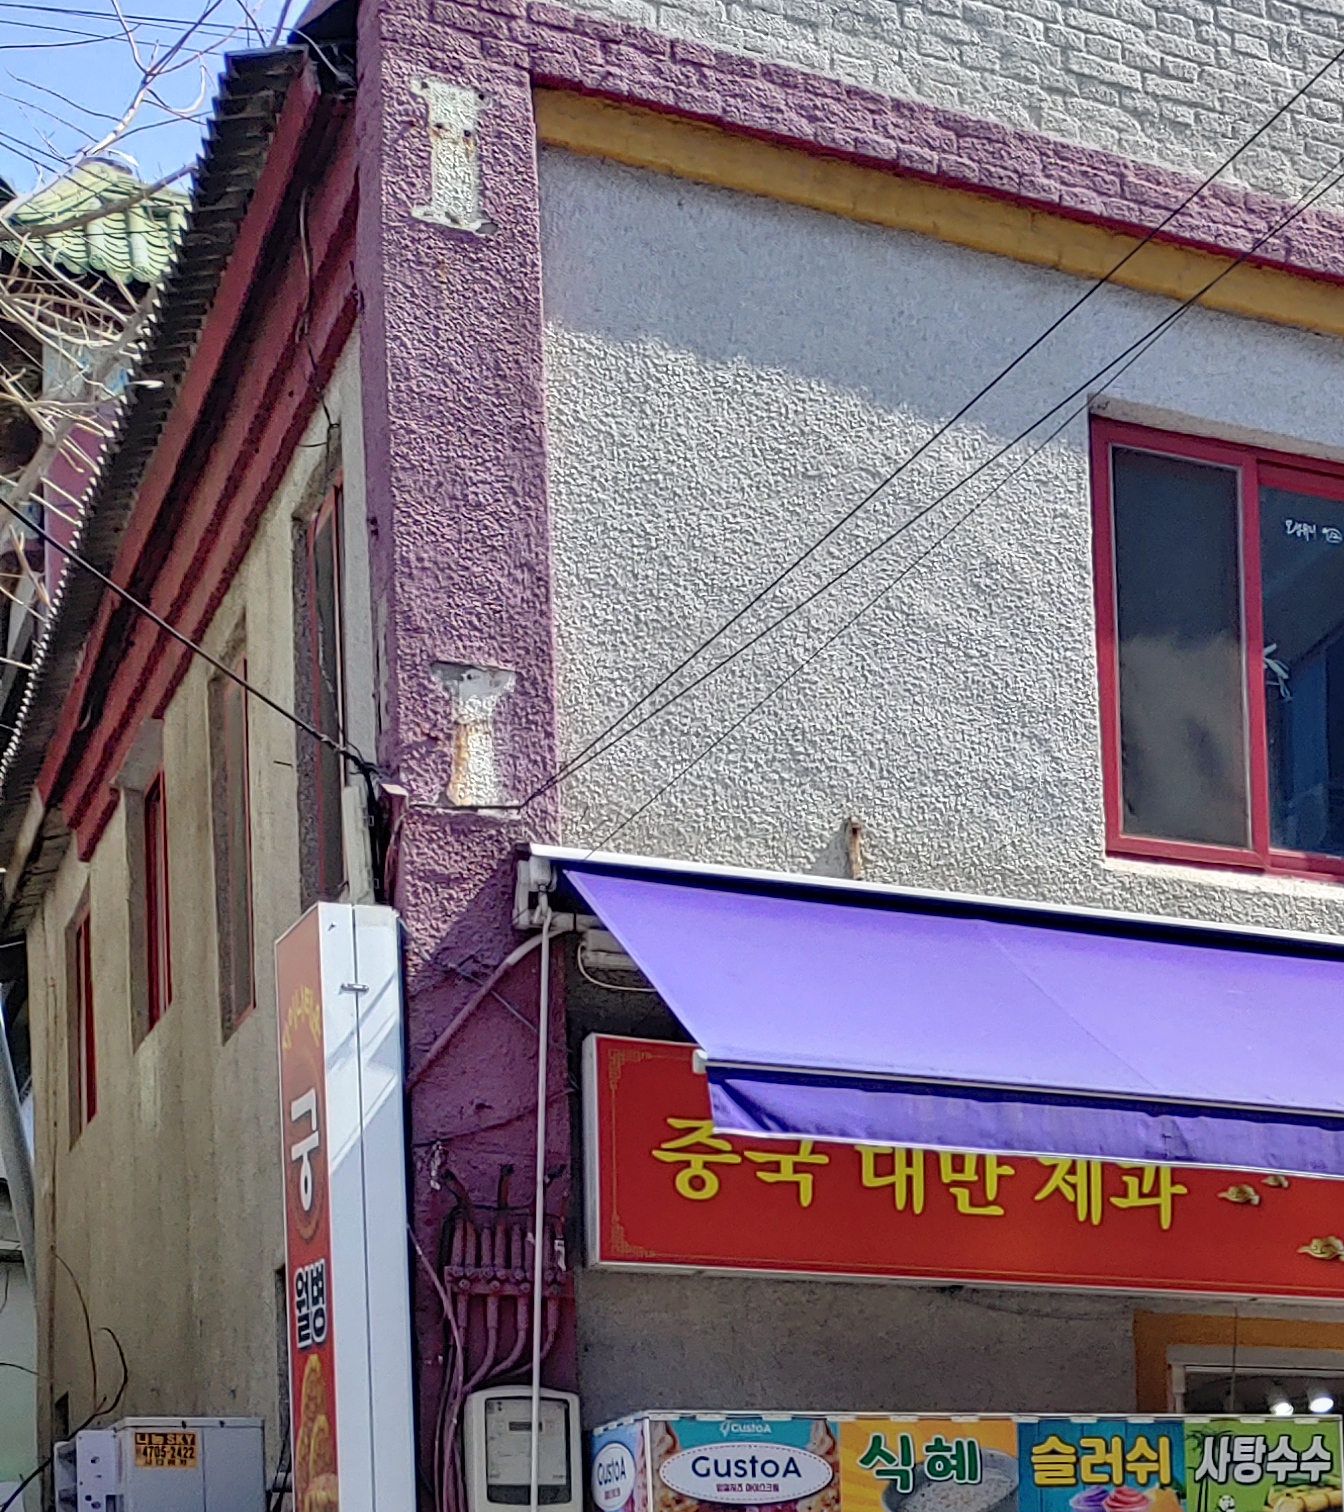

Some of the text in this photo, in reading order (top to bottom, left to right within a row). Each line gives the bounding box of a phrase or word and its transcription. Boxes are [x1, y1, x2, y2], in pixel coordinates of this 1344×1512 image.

[597, 1456, 628, 1486] GustoA
[691, 1456, 802, 1479] GustoA
[859, 1434, 982, 1493] 식혜
[1031, 1437, 1172, 1487] 슬러쉬
[1195, 1436, 1334, 1482] 사탕수수
